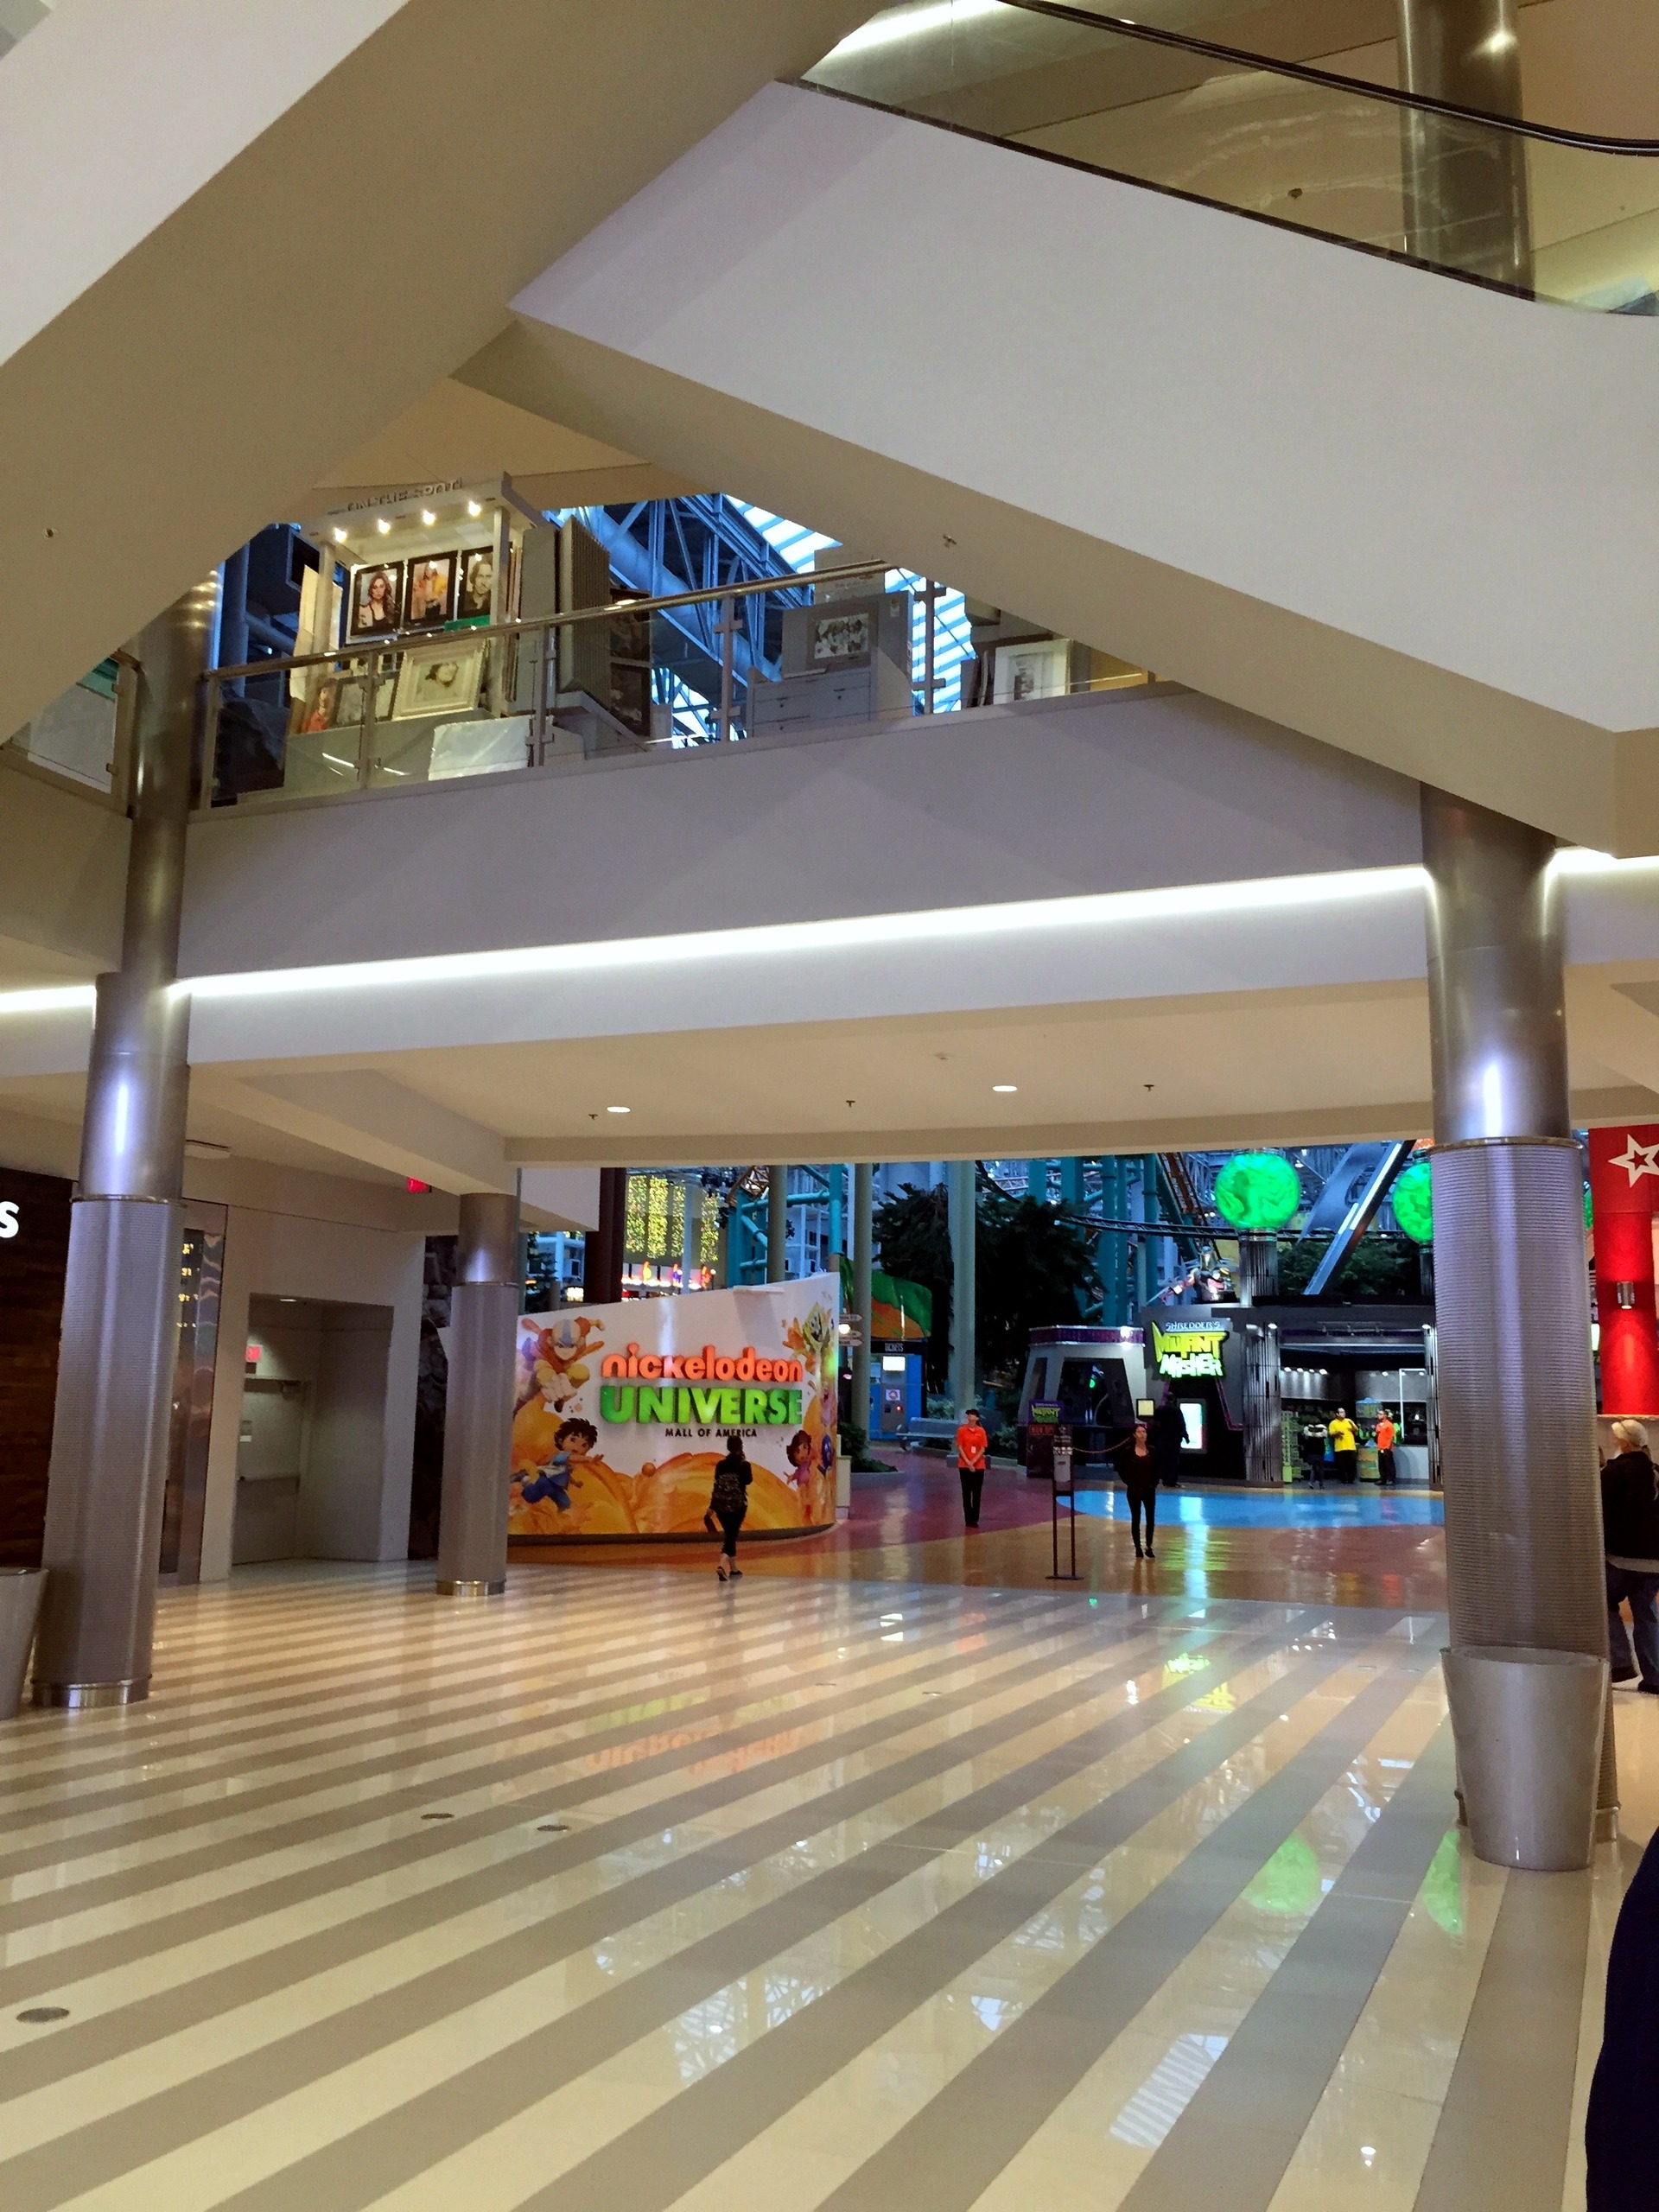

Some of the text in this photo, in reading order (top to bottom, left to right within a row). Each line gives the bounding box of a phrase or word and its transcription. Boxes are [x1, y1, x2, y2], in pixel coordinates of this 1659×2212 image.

[1165, 1321, 1221, 1331] SHREDDER'S
[1152, 1322, 1227, 1363] MUTANT
[601, 1342, 803, 1382] nickelodeon
[1160, 1353, 1224, 1378] MASHER
[600, 1385, 803, 1424] UNIVERSE
[665, 1428, 757, 1438] MALL OF AMERICA
